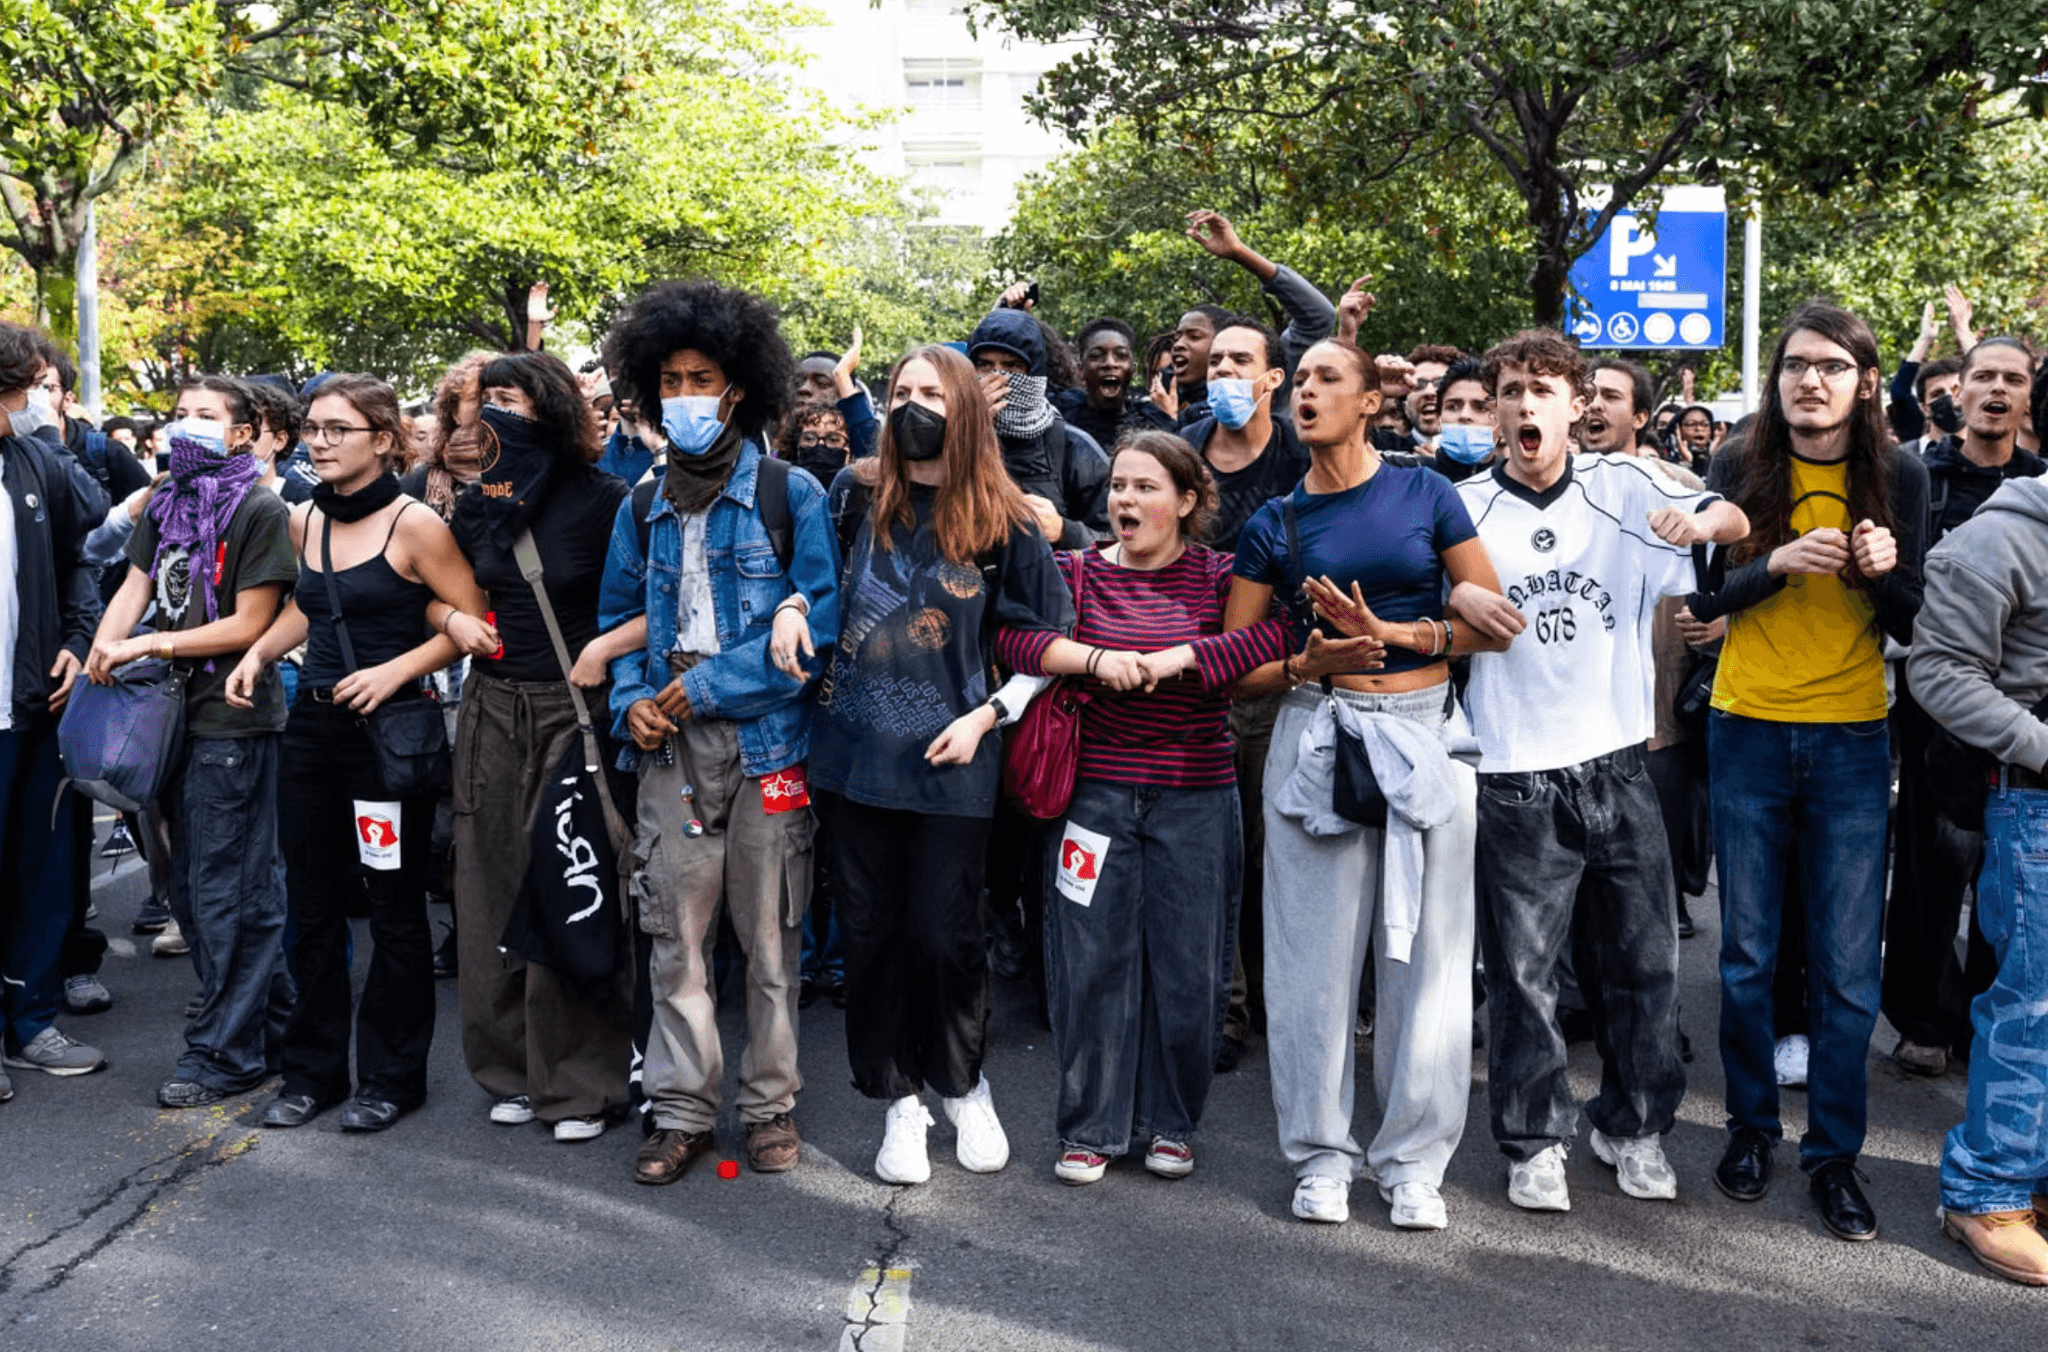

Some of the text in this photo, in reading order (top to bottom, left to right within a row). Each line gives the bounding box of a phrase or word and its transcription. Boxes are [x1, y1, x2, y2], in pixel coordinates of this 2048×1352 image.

[1610, 214, 1659, 277] P
[1535, 606, 1577, 645] 678
[919, 679, 942, 705] LOS
